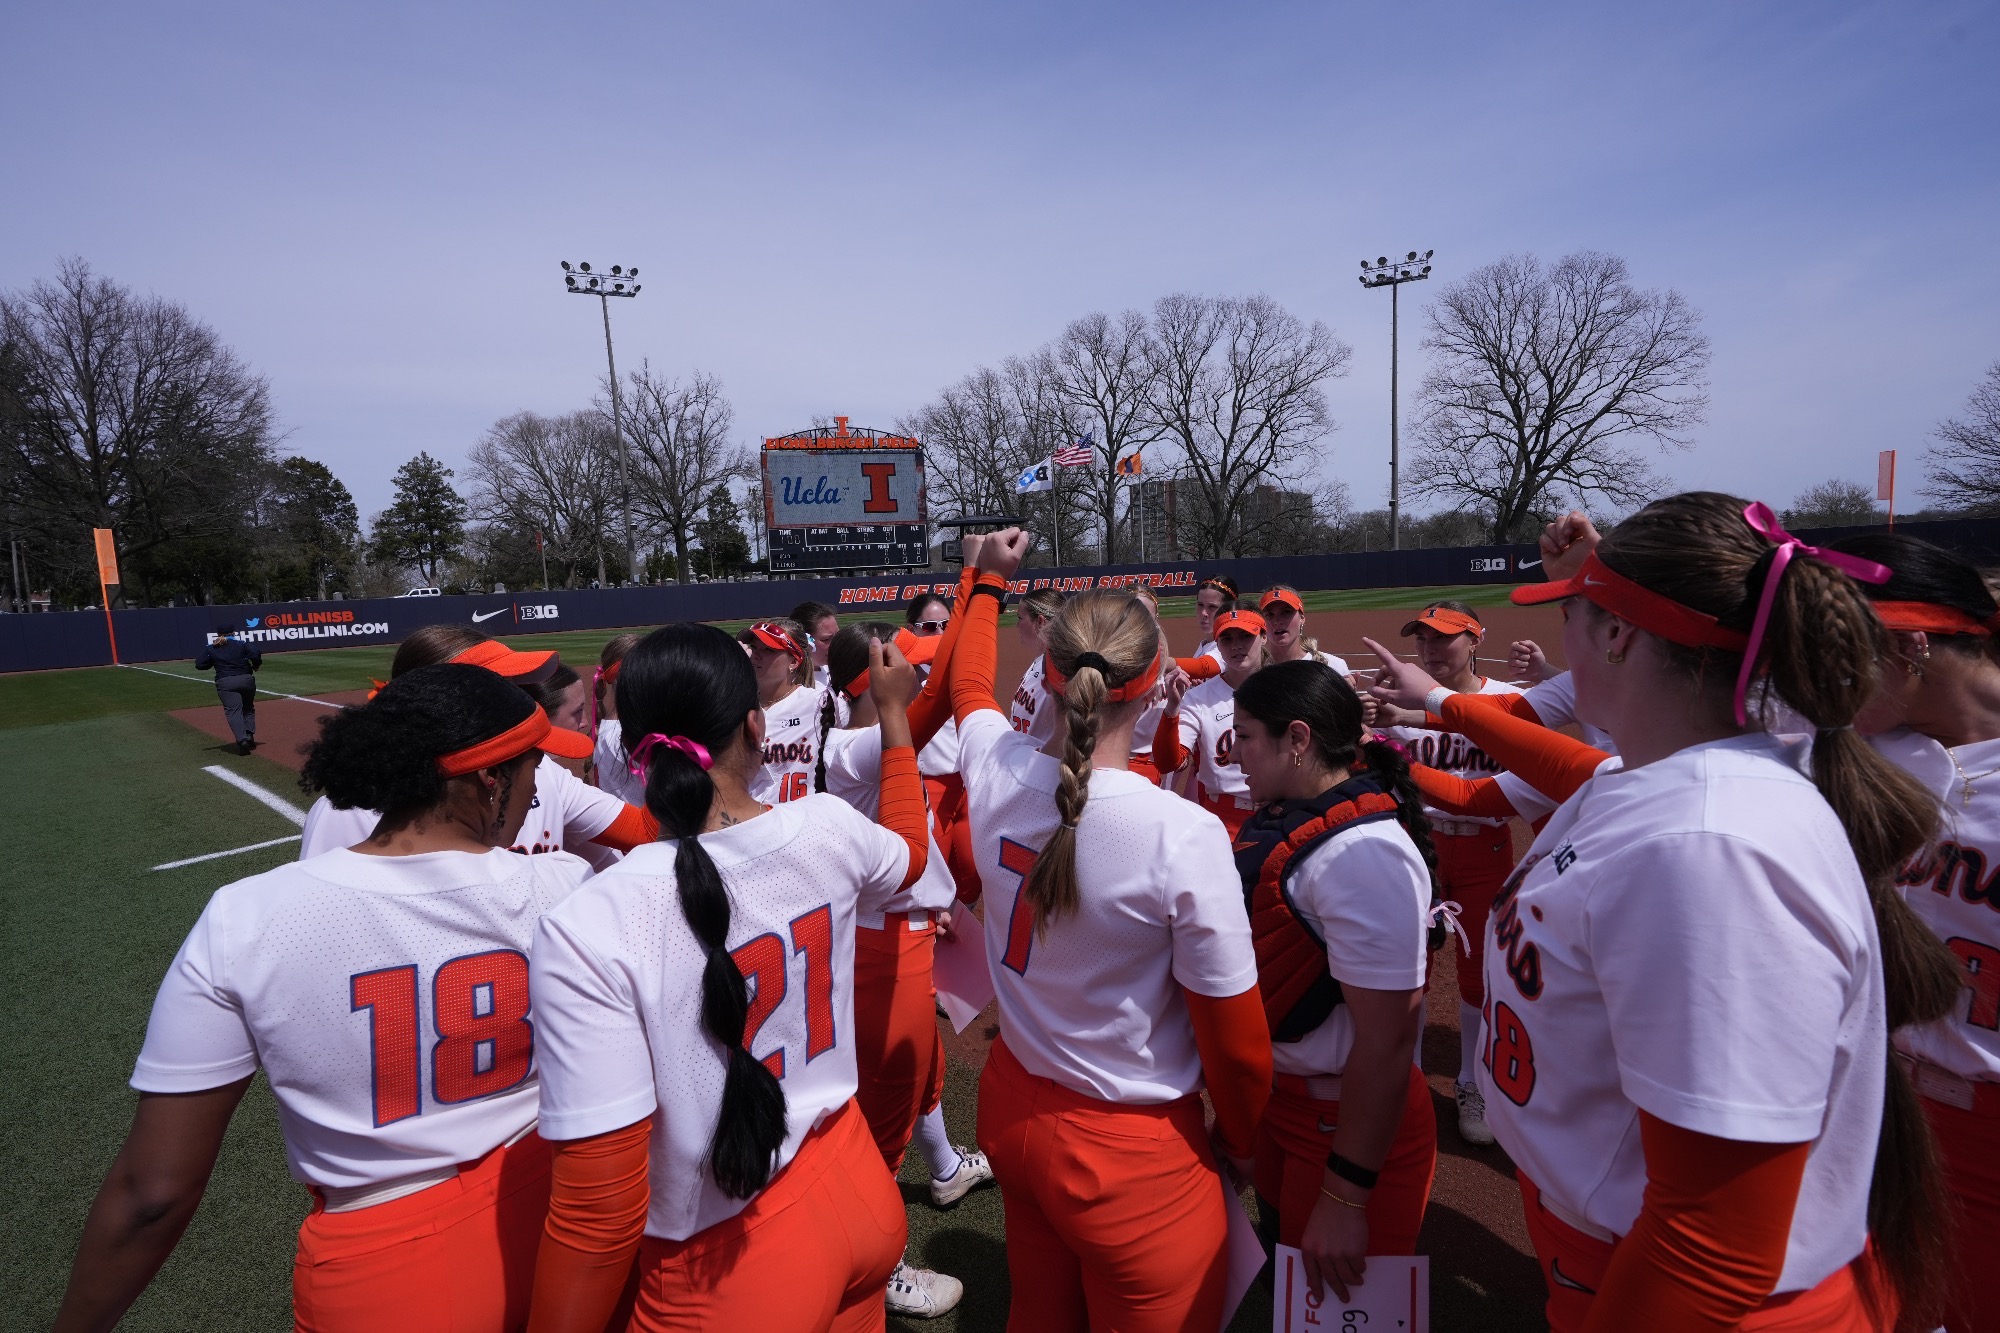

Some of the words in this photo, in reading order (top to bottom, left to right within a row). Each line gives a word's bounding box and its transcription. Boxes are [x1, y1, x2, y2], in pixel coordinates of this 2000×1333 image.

[765, 437, 874, 449] EICHELBERGER
[878, 437, 919, 449] FIELD
[839, 585, 899, 604] HOME
[901, 584, 930, 600] OF
[1033, 576, 1095, 592] ILLINI
[1097, 571, 1198, 590] SOFTBALL
[264, 610, 354, 629] @ILLINISB
[779, 771, 808, 803] 16
[727, 902, 836, 1081] 21
[350, 948, 535, 1129] 18
